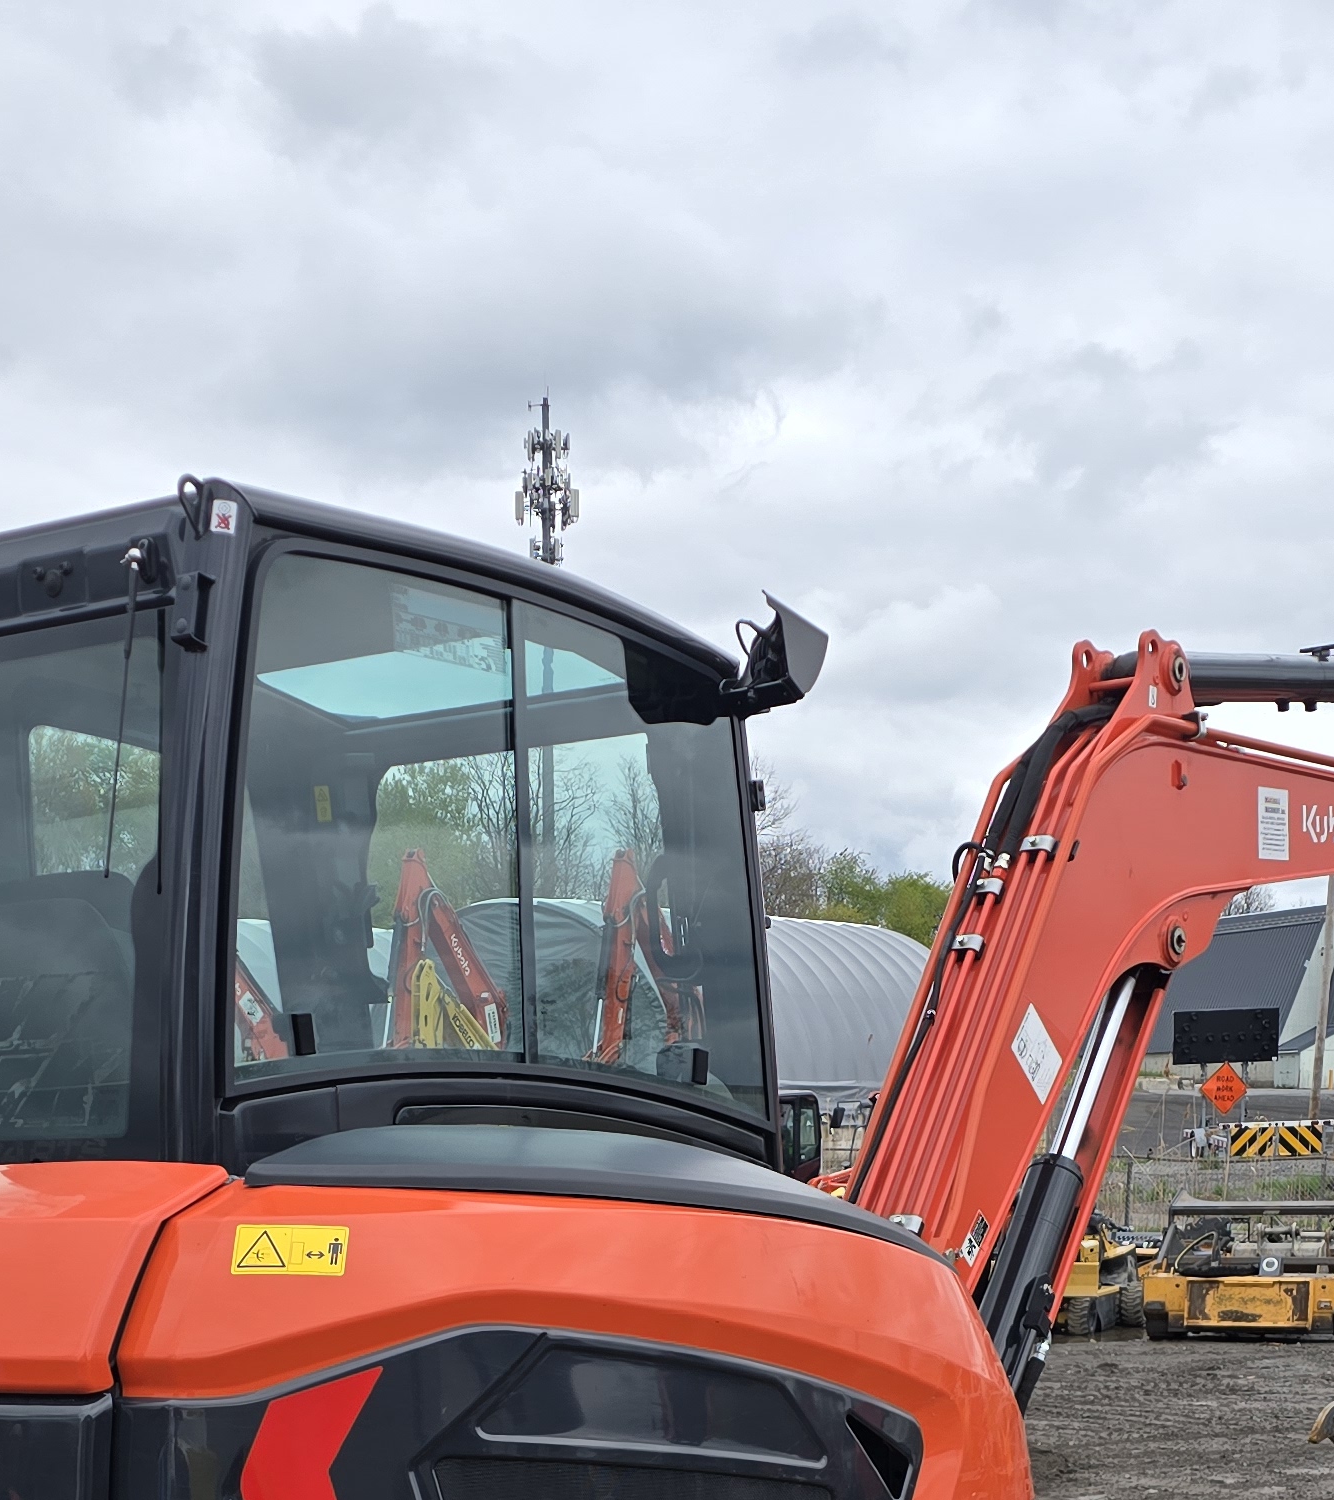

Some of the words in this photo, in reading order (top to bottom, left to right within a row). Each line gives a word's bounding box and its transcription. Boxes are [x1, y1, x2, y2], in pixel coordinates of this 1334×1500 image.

[450, 933, 471, 976] Kubota
[1216, 1075, 1235, 1083] ROAD
[1216, 1084, 1234, 1093] WORK
[1213, 1094, 1235, 1102] AHEAD
